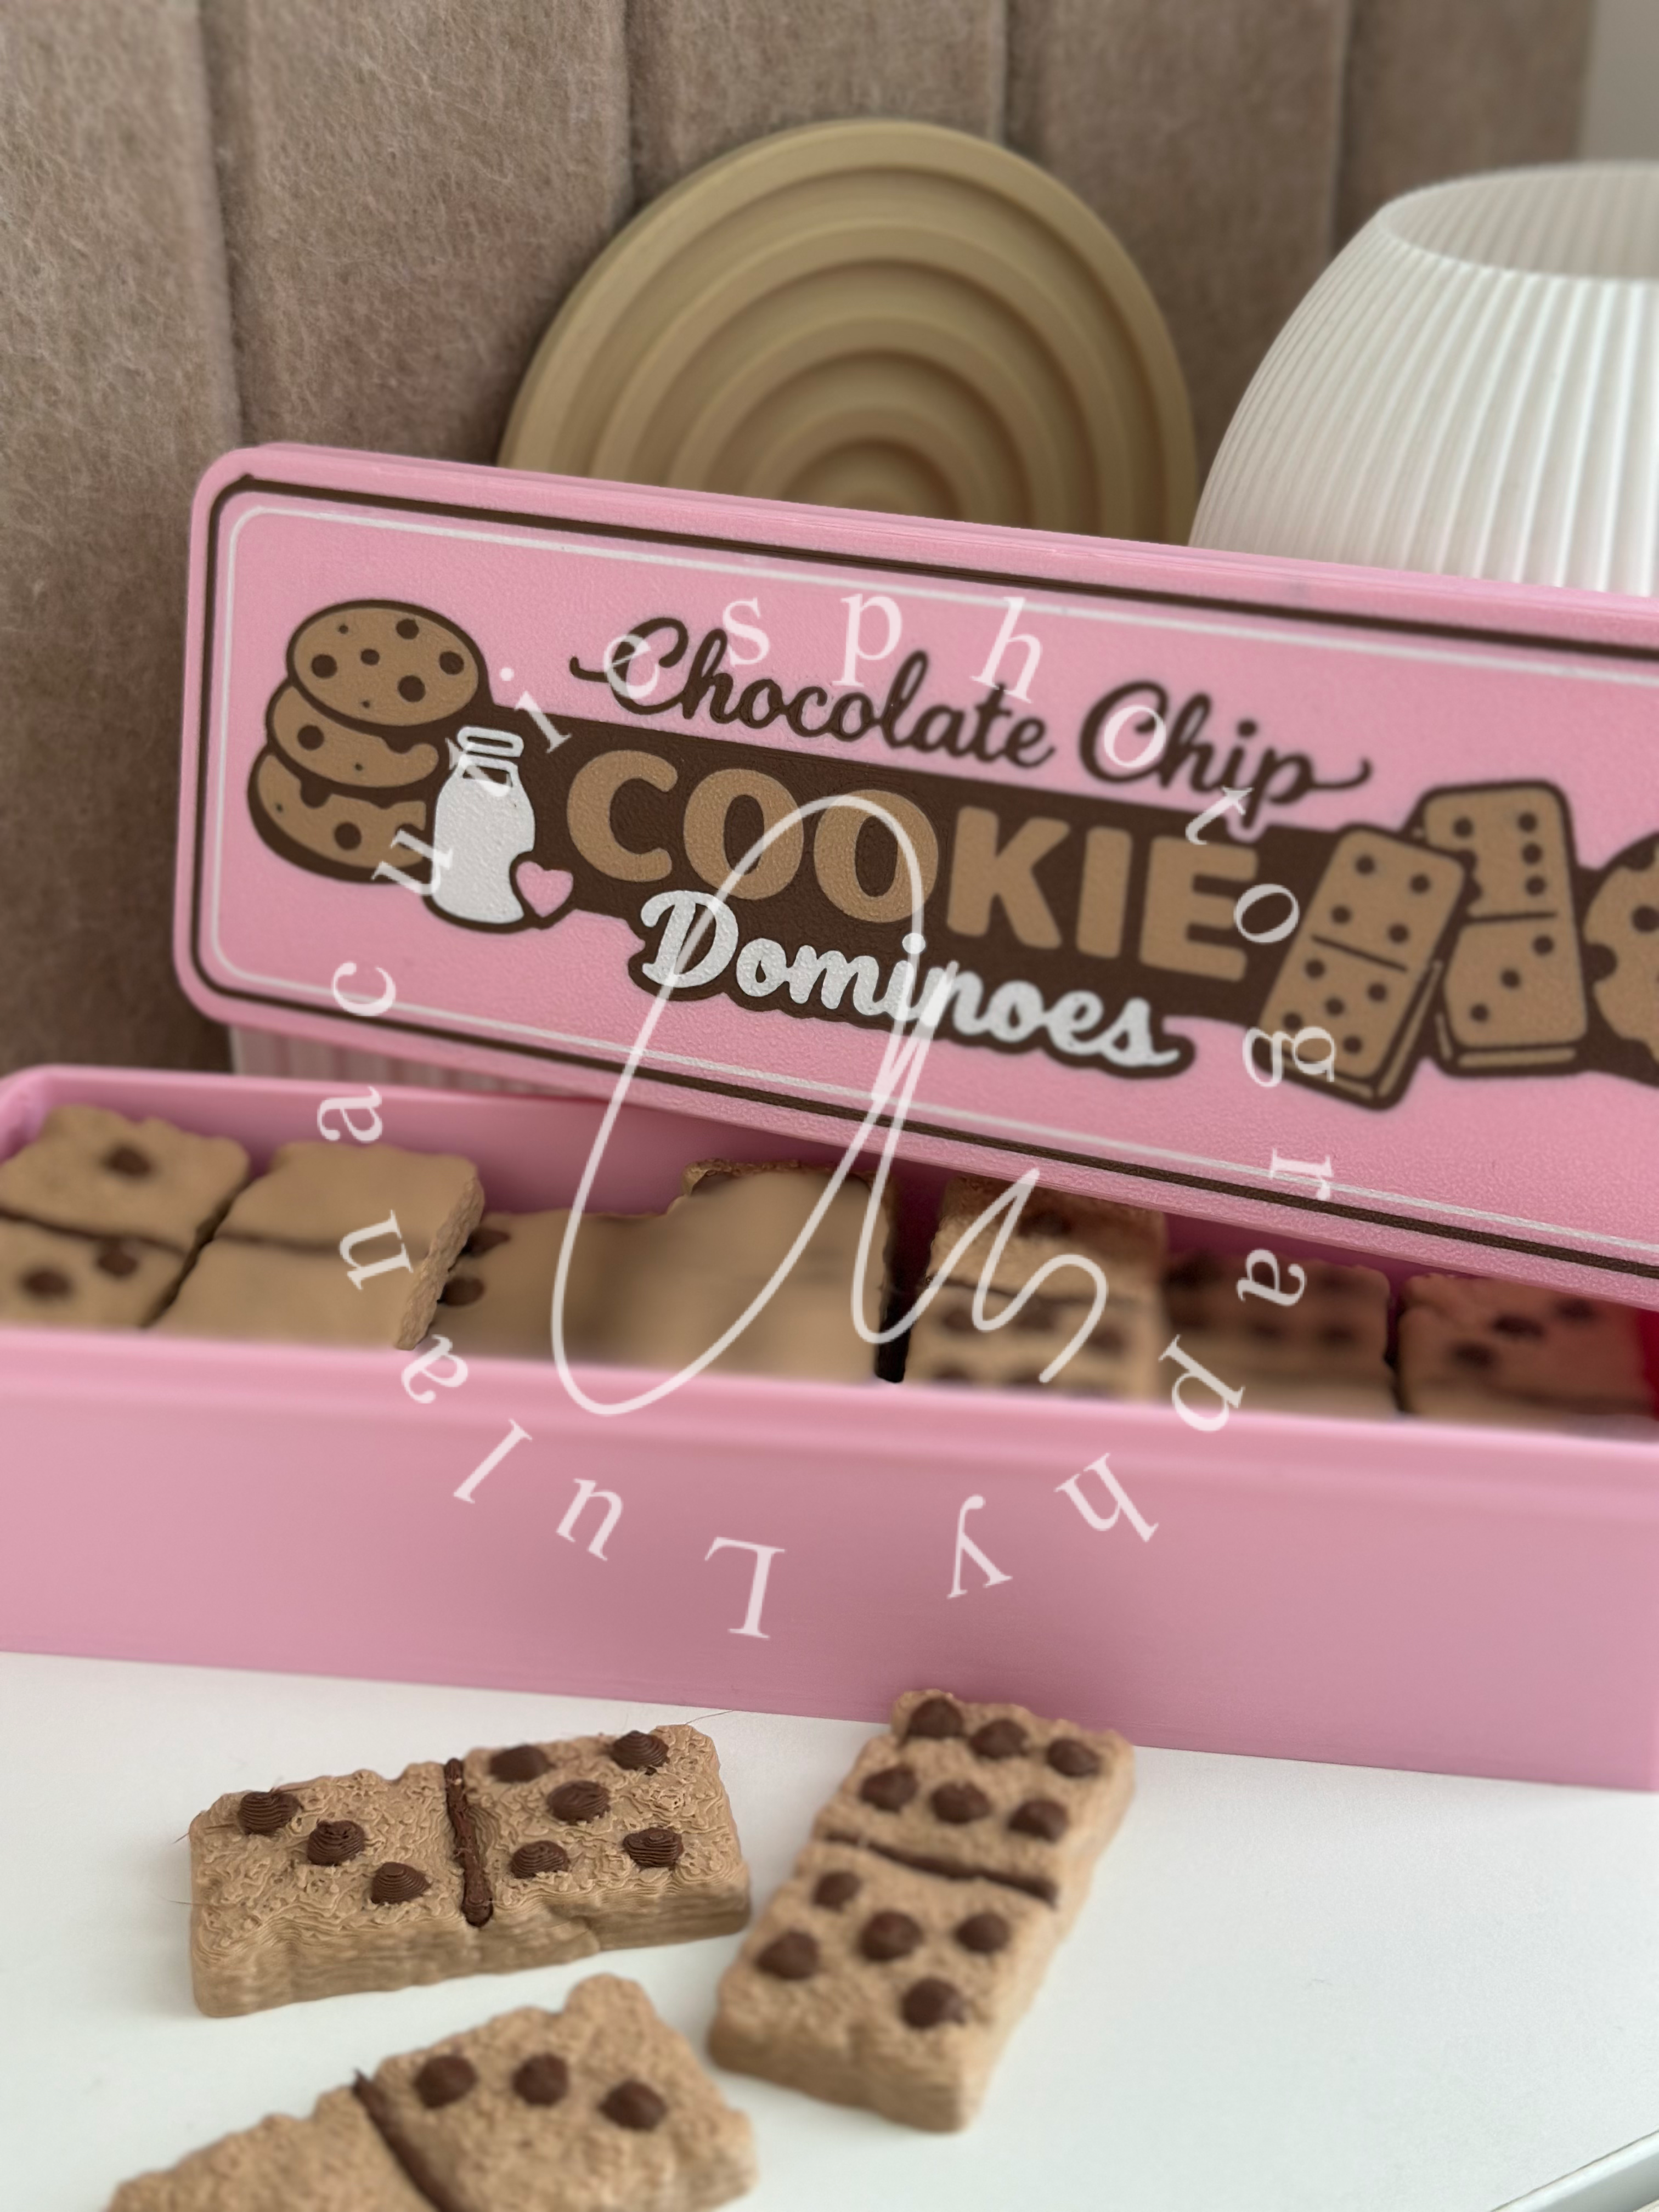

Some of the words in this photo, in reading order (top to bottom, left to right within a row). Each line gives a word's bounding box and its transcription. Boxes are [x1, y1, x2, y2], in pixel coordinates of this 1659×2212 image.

[569, 617, 1056, 768] Chocolate
[1079, 680, 1373, 830] Chip
[566, 749, 1258, 982] COOKIE
[640, 890, 1180, 1067] Dominoes
